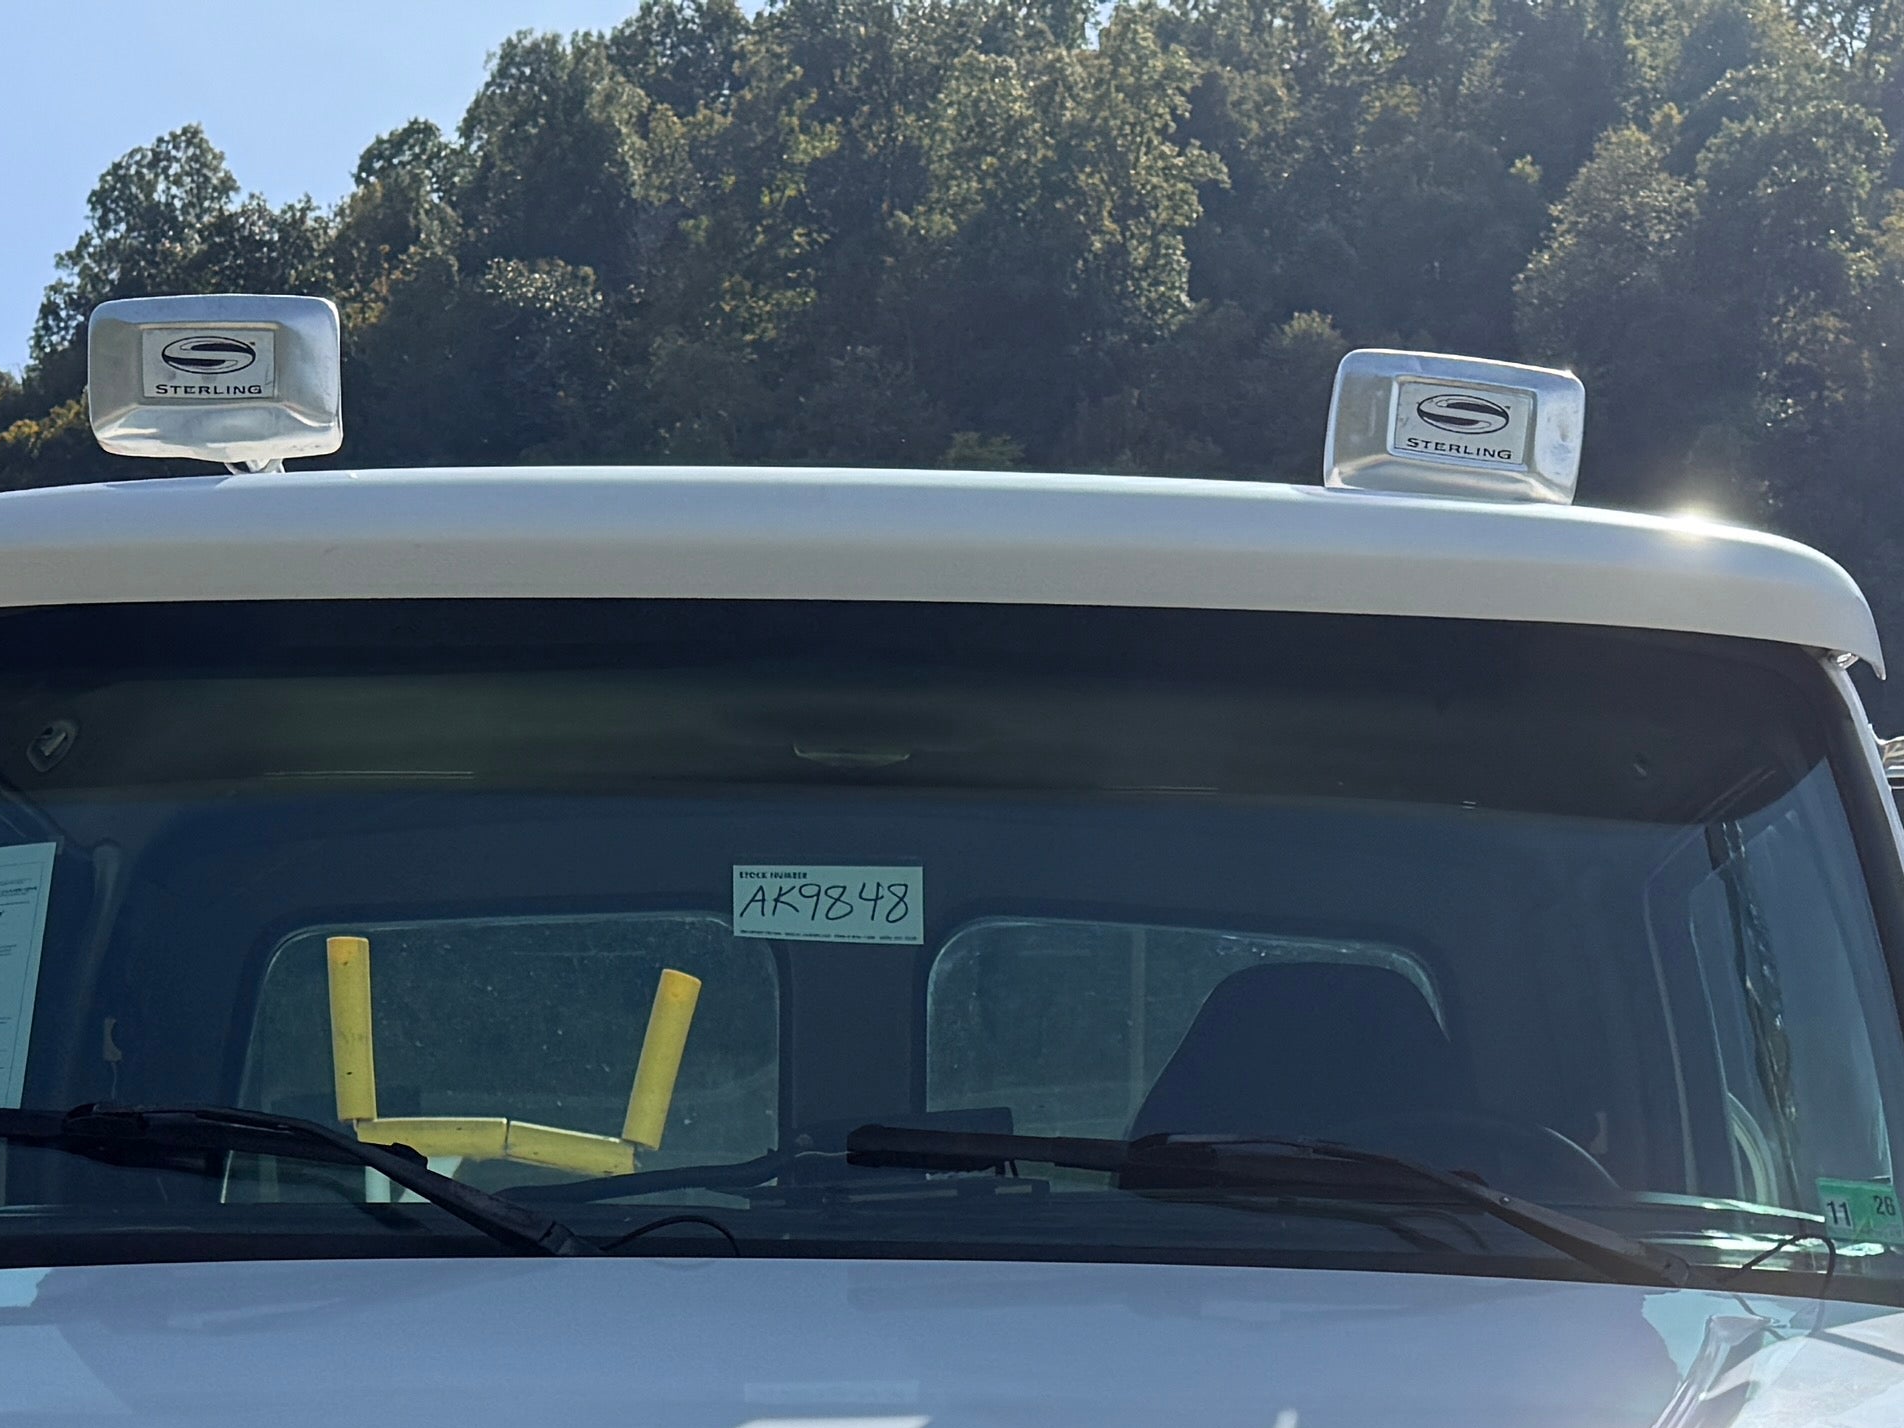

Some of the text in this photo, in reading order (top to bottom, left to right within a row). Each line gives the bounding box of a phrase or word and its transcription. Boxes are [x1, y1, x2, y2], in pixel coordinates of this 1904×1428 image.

[155, 384, 263, 396] STERLING
[1406, 437, 1512, 460] STERLING
[740, 881, 909, 924] AK9848
[1826, 1200, 1852, 1227] 11
